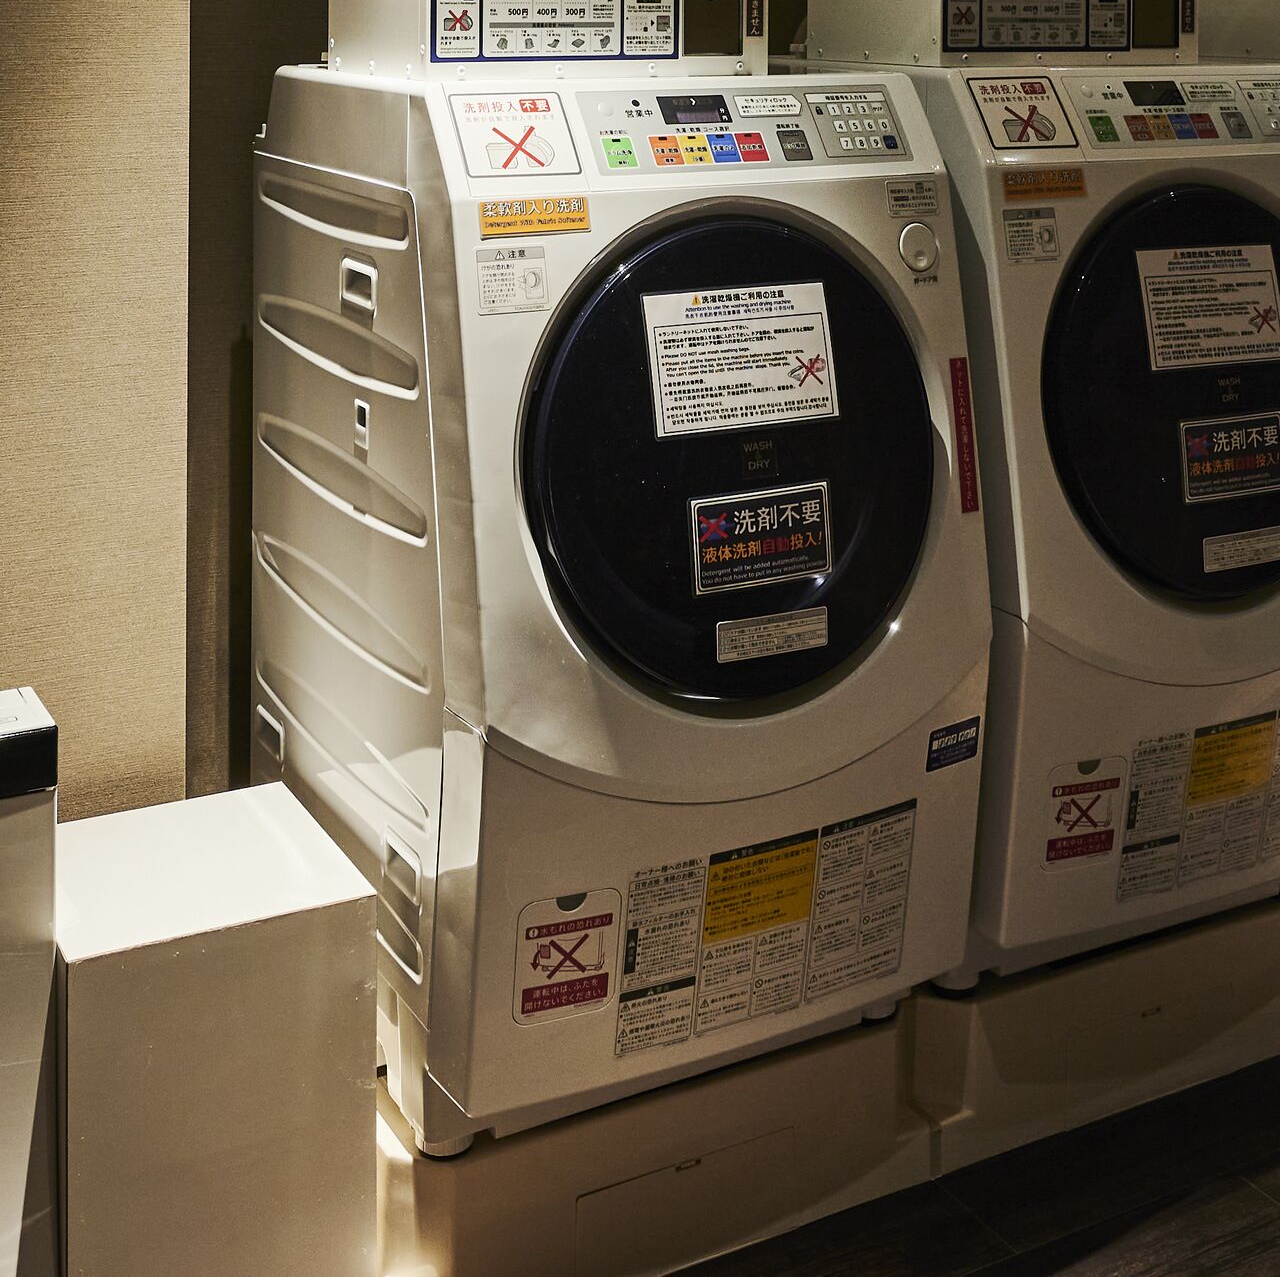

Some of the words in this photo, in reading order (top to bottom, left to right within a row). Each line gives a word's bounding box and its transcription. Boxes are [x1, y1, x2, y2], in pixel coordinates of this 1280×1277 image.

[508, 8, 529, 16] 500円
[537, 8, 557, 16] 400円
[565, 8, 586, 16] 300円
[978, 84, 1021, 95] 洗剤投入
[463, 101, 518, 114] 洗剤投入
[522, 100, 550, 112] 不要
[625, 109, 654, 118] 営業中
[859, 139, 865, 147] 8
[483, 197, 585, 217] 柔軟剤入り洗剤
[507, 249, 526, 259] 注意
[701, 290, 785, 304] 洗濯乾燥機ご利用の注意
[1221, 393, 1240, 402] DRY
[1212, 425, 1278, 453] 洗剤不要
[743, 440, 773, 453] WASH
[747, 459, 770, 470] DRY
[733, 499, 821, 535] 洗剤不要
[701, 567, 731, 577] Detergent
[753, 561, 771, 569] added
[702, 578, 713, 586] You
[722, 575, 733, 583] not
[733, 573, 747, 581] have
[755, 571, 765, 579] put
[772, 568, 782, 576] any
[783, 563, 806, 574] washing
[539, 915, 611, 936] 水もれの恐れあり
[524, 989, 605, 1011] 開けないでください。
